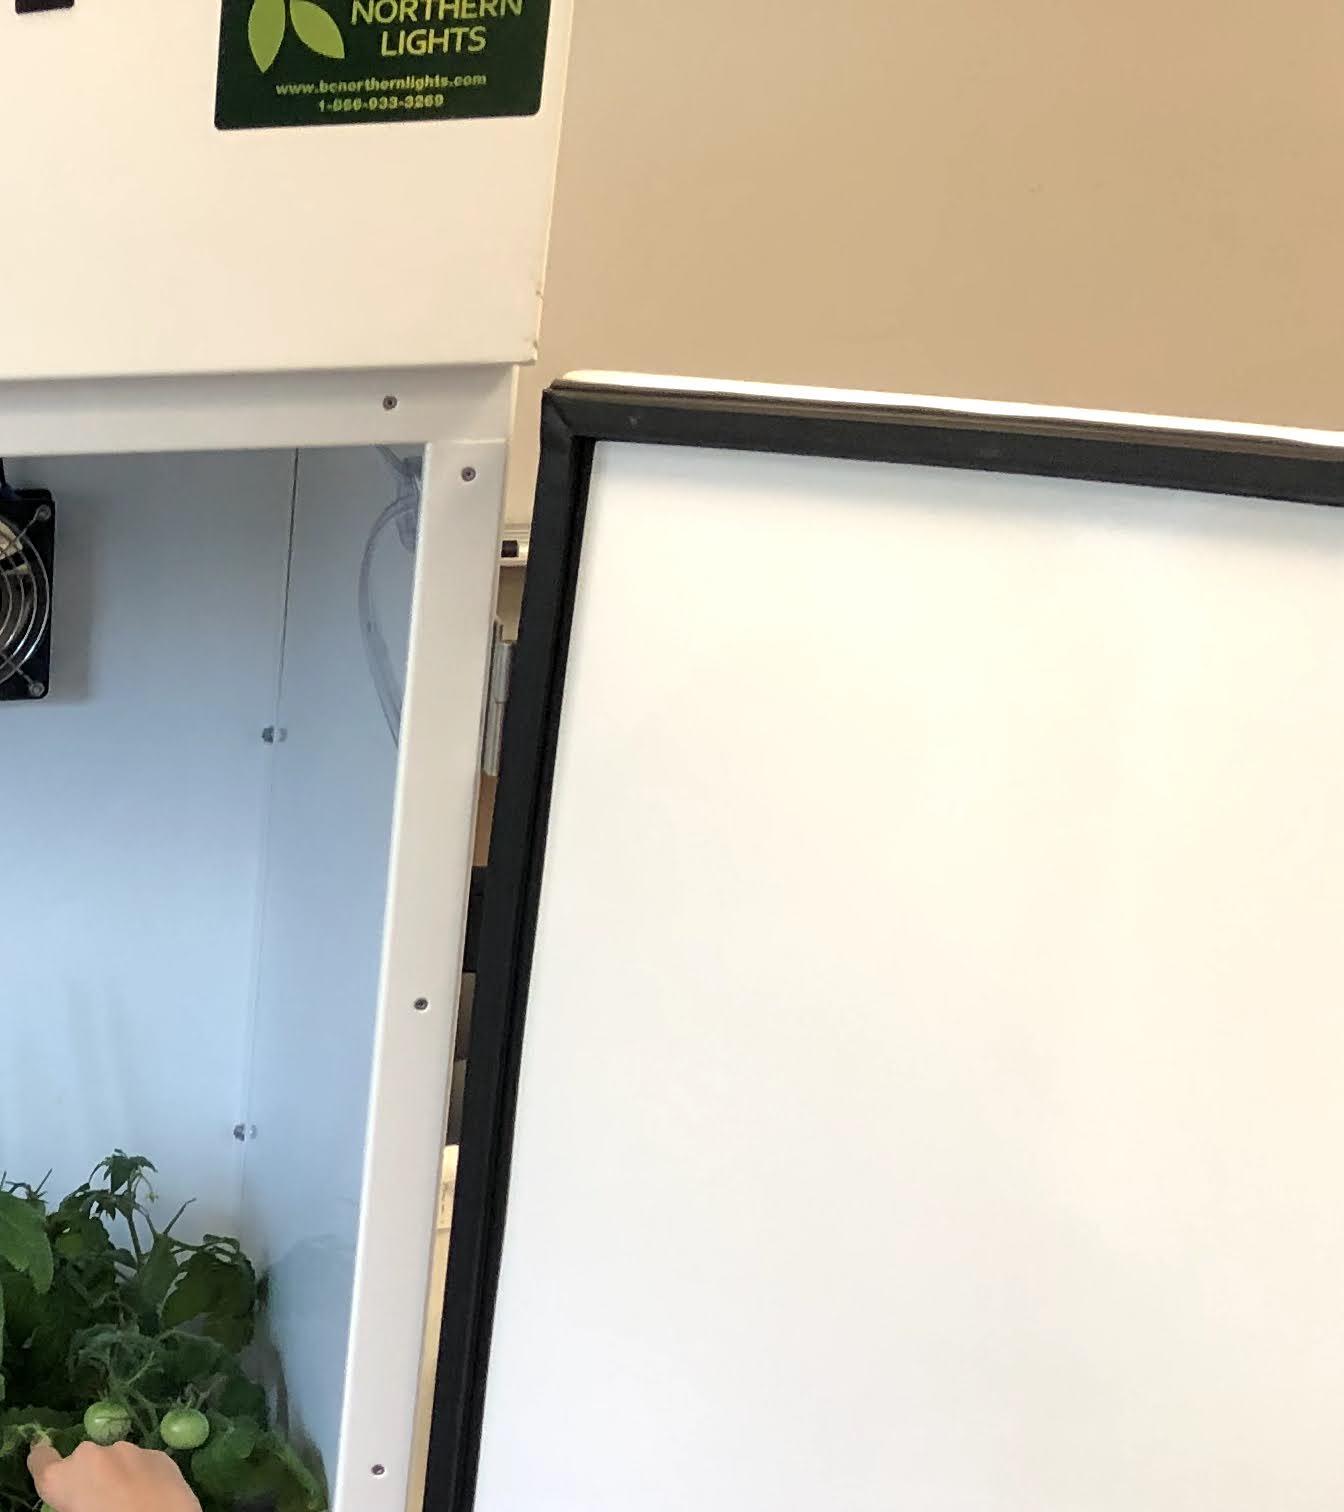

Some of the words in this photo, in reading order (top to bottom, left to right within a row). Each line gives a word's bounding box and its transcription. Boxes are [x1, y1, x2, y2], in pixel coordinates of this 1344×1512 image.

[351, 0, 523, 25] NORTHERN
[381, 25, 487, 57] LIGHTS
[275, 73, 488, 96] www.bcnorthernlights.com
